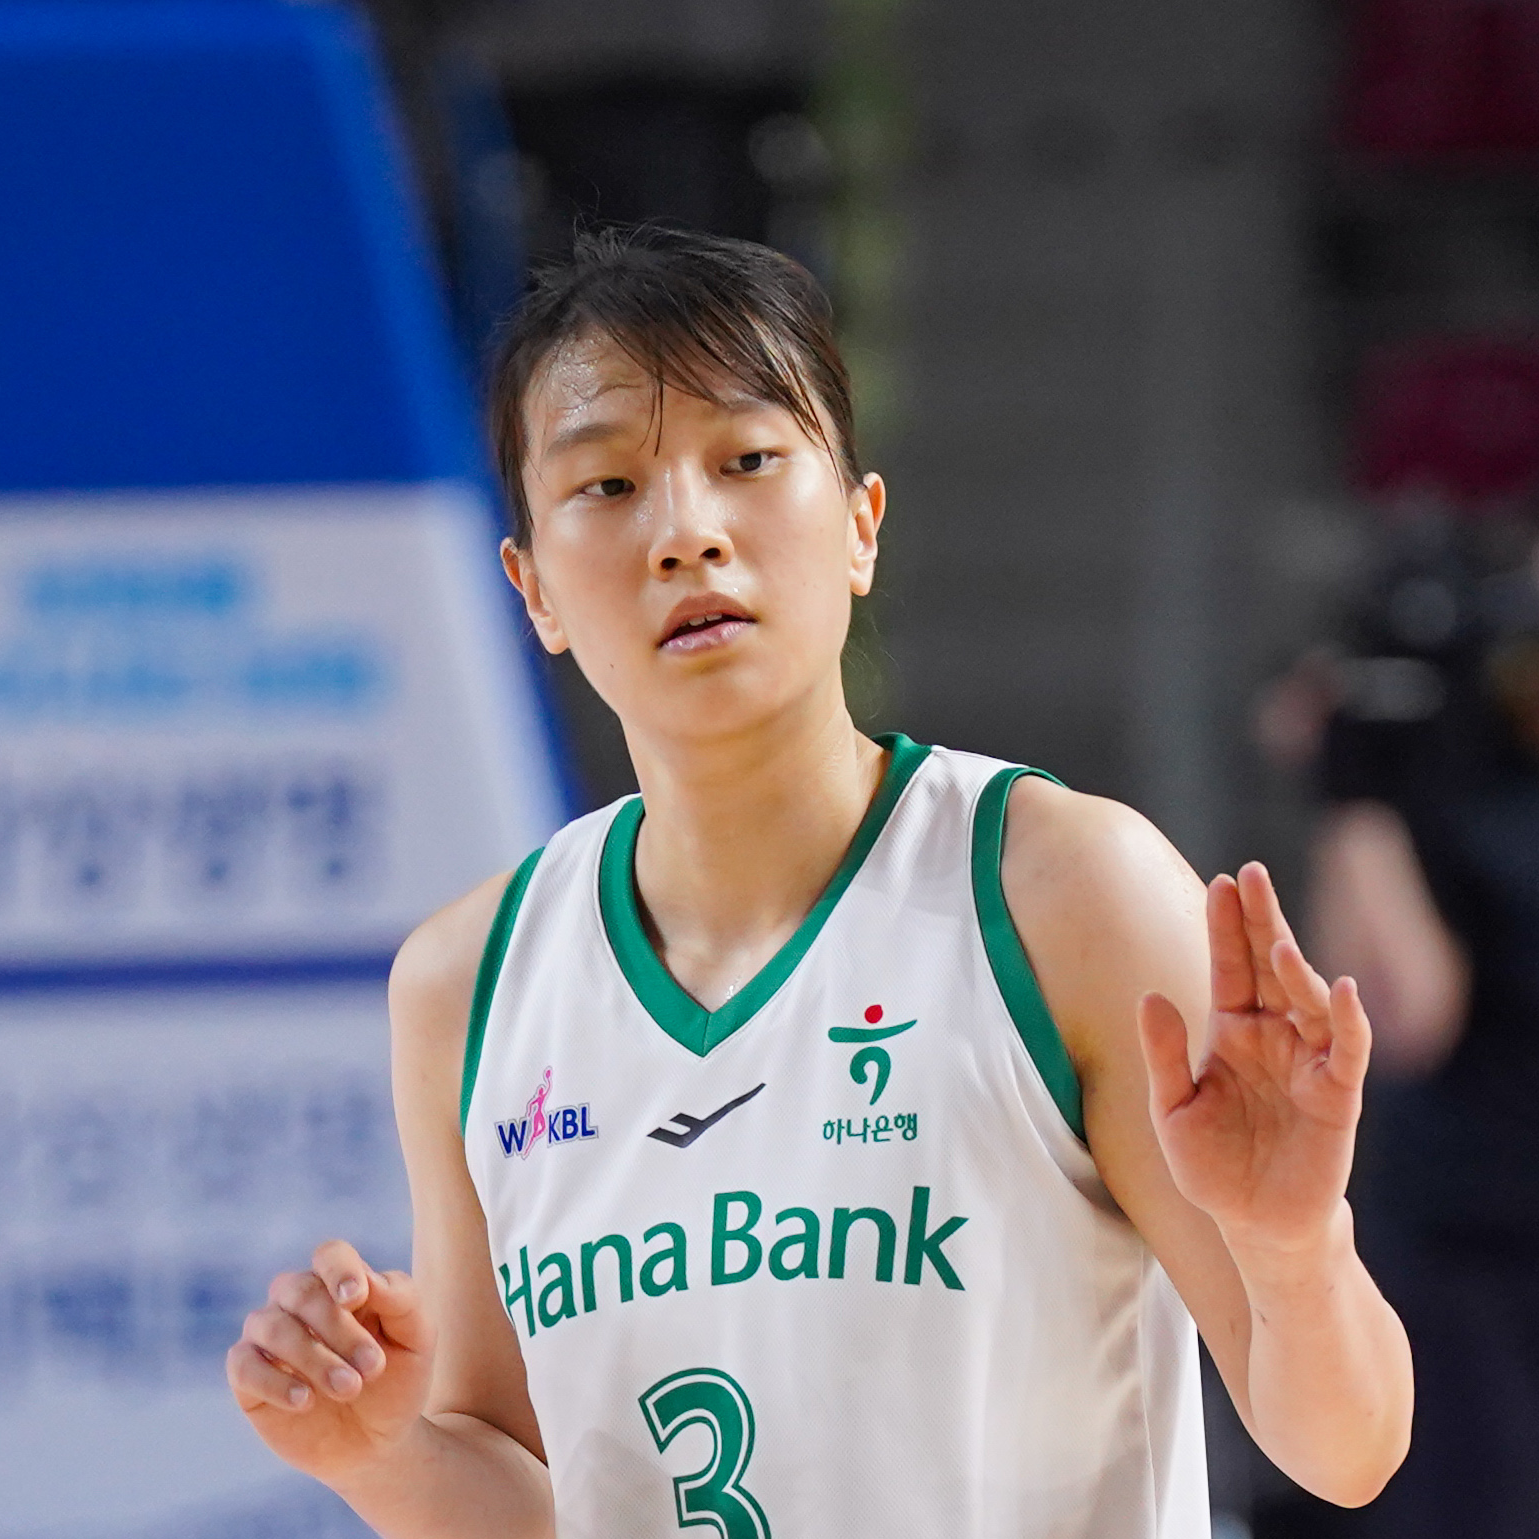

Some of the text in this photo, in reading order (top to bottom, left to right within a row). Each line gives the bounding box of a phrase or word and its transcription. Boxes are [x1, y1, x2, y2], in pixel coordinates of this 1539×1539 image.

[822, 1112, 918, 1146] 하나은행
[500, 1187, 968, 1336] Hana Bank
